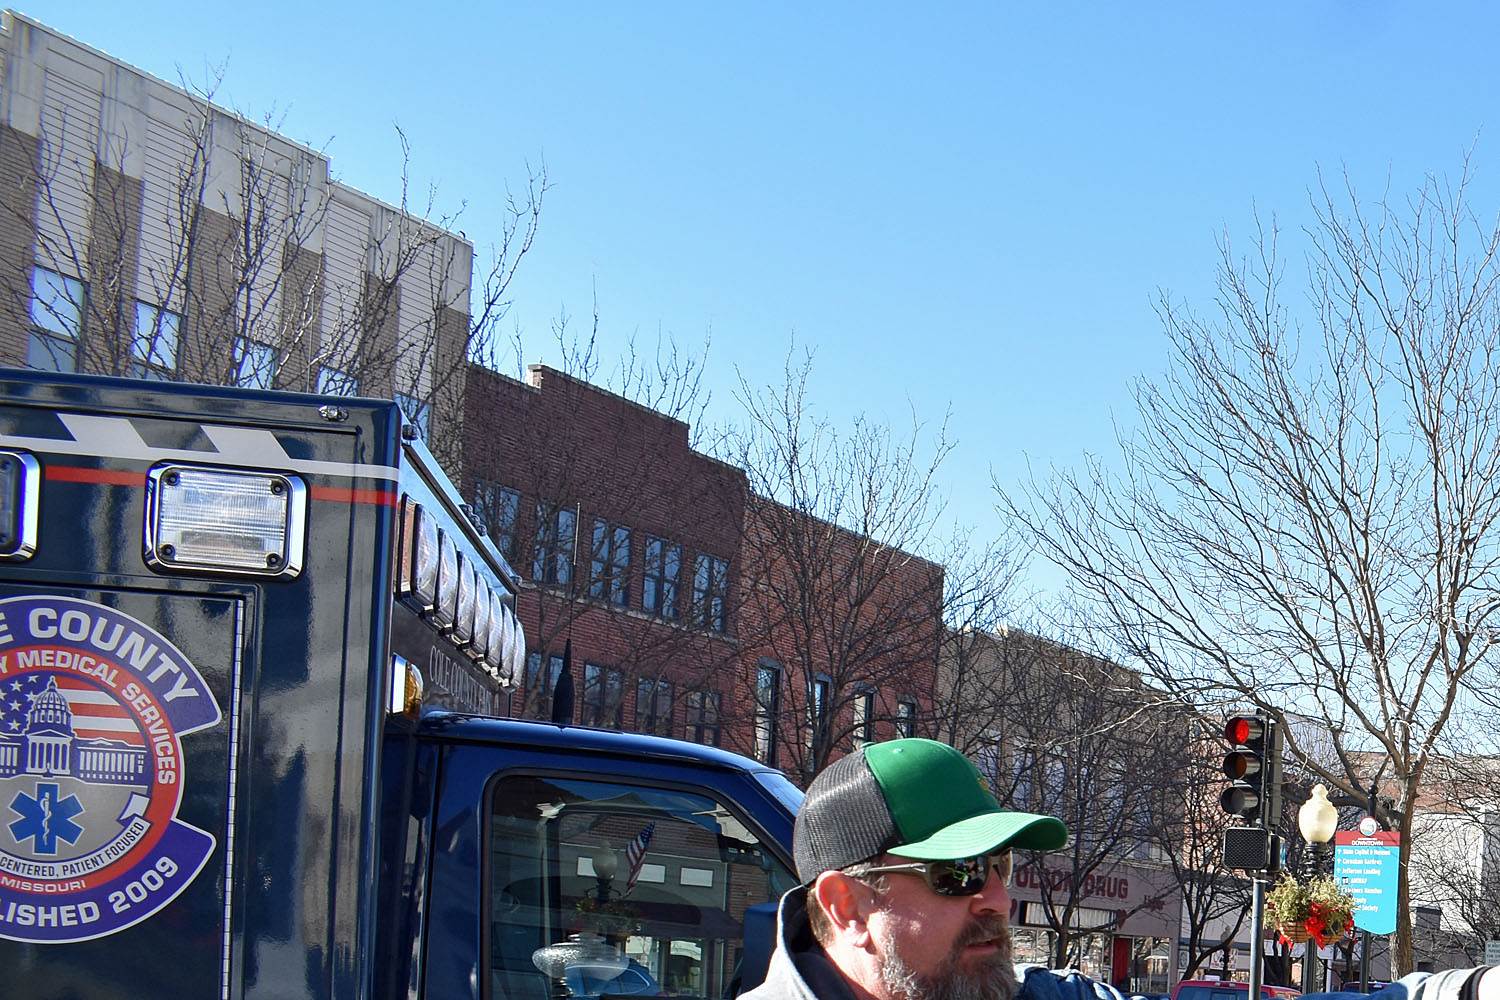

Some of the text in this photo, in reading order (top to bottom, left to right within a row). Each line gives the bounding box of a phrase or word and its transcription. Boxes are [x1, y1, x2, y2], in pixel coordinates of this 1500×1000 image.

[28, 607, 200, 703] COUNTY
[430, 645, 451, 692] COLE
[17, 649, 176, 785] MEDICAL SERVICES
[0, 821, 145, 878] CENTERED, PATIENT FOCUSED
[0, 875, 87, 893] MISSOURI
[0, 856, 179, 928] ISHED 2009
[1014, 867, 1129, 899] OLSON DRUG
